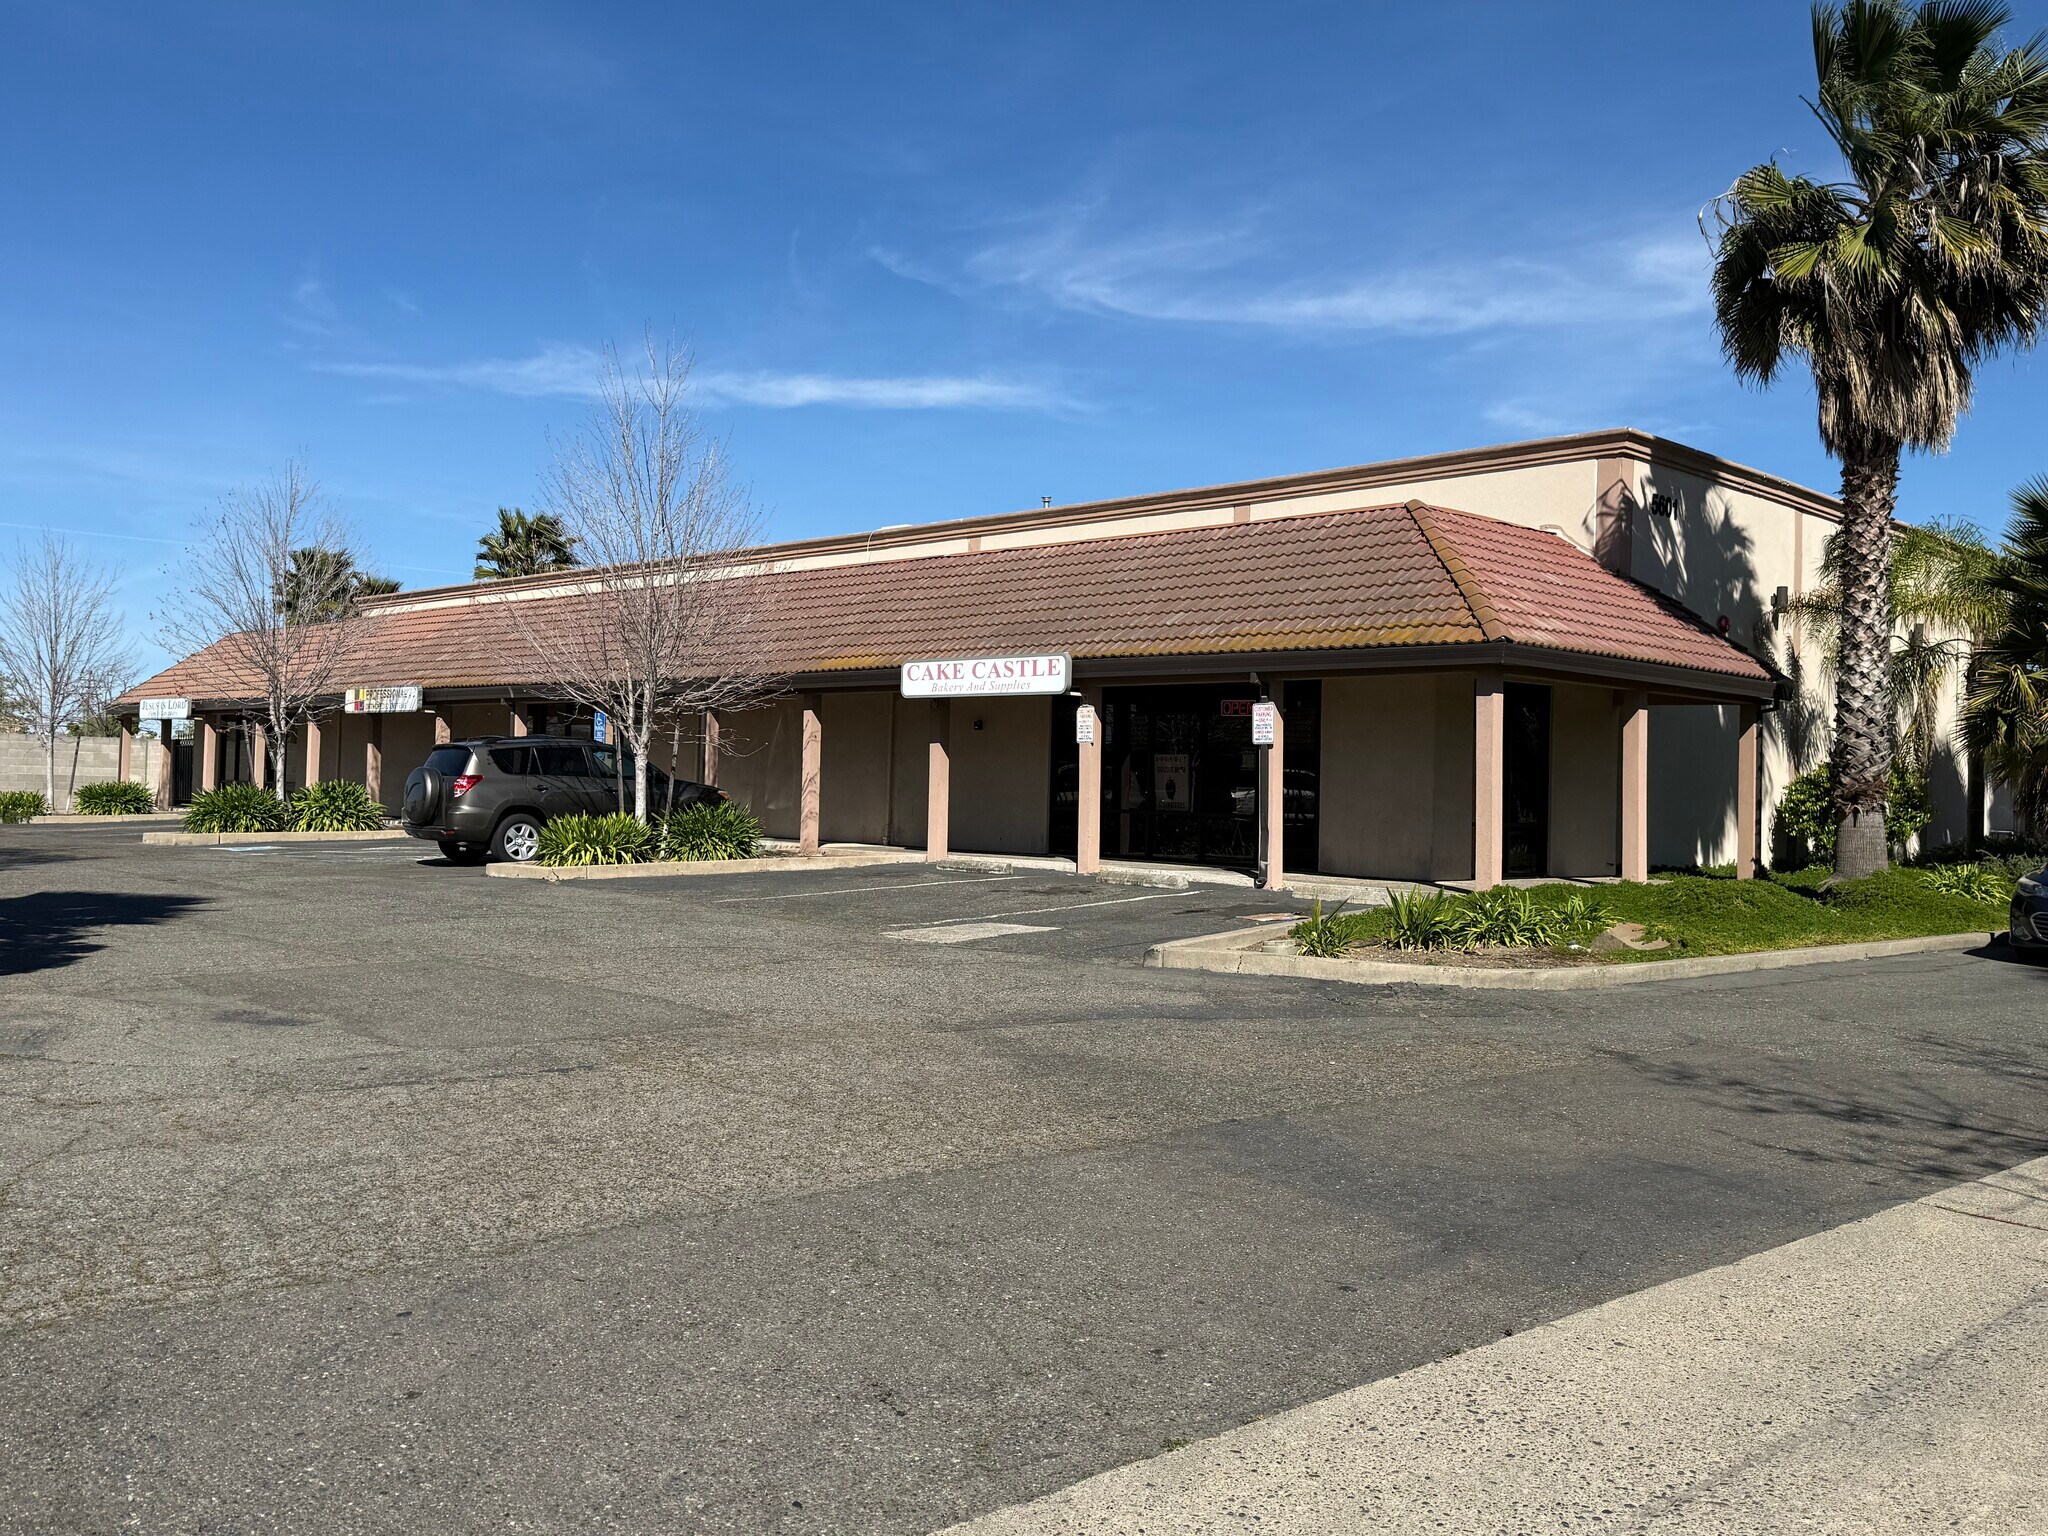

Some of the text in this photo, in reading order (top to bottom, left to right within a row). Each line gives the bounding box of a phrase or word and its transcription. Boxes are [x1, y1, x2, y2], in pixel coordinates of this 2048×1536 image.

[1651, 493, 1678, 520] 5601
[906, 658, 1061, 681] CAKE CASTLE
[931, 679, 1031, 693] Bakery And Supplies
[168, 699, 187, 710] LORD
